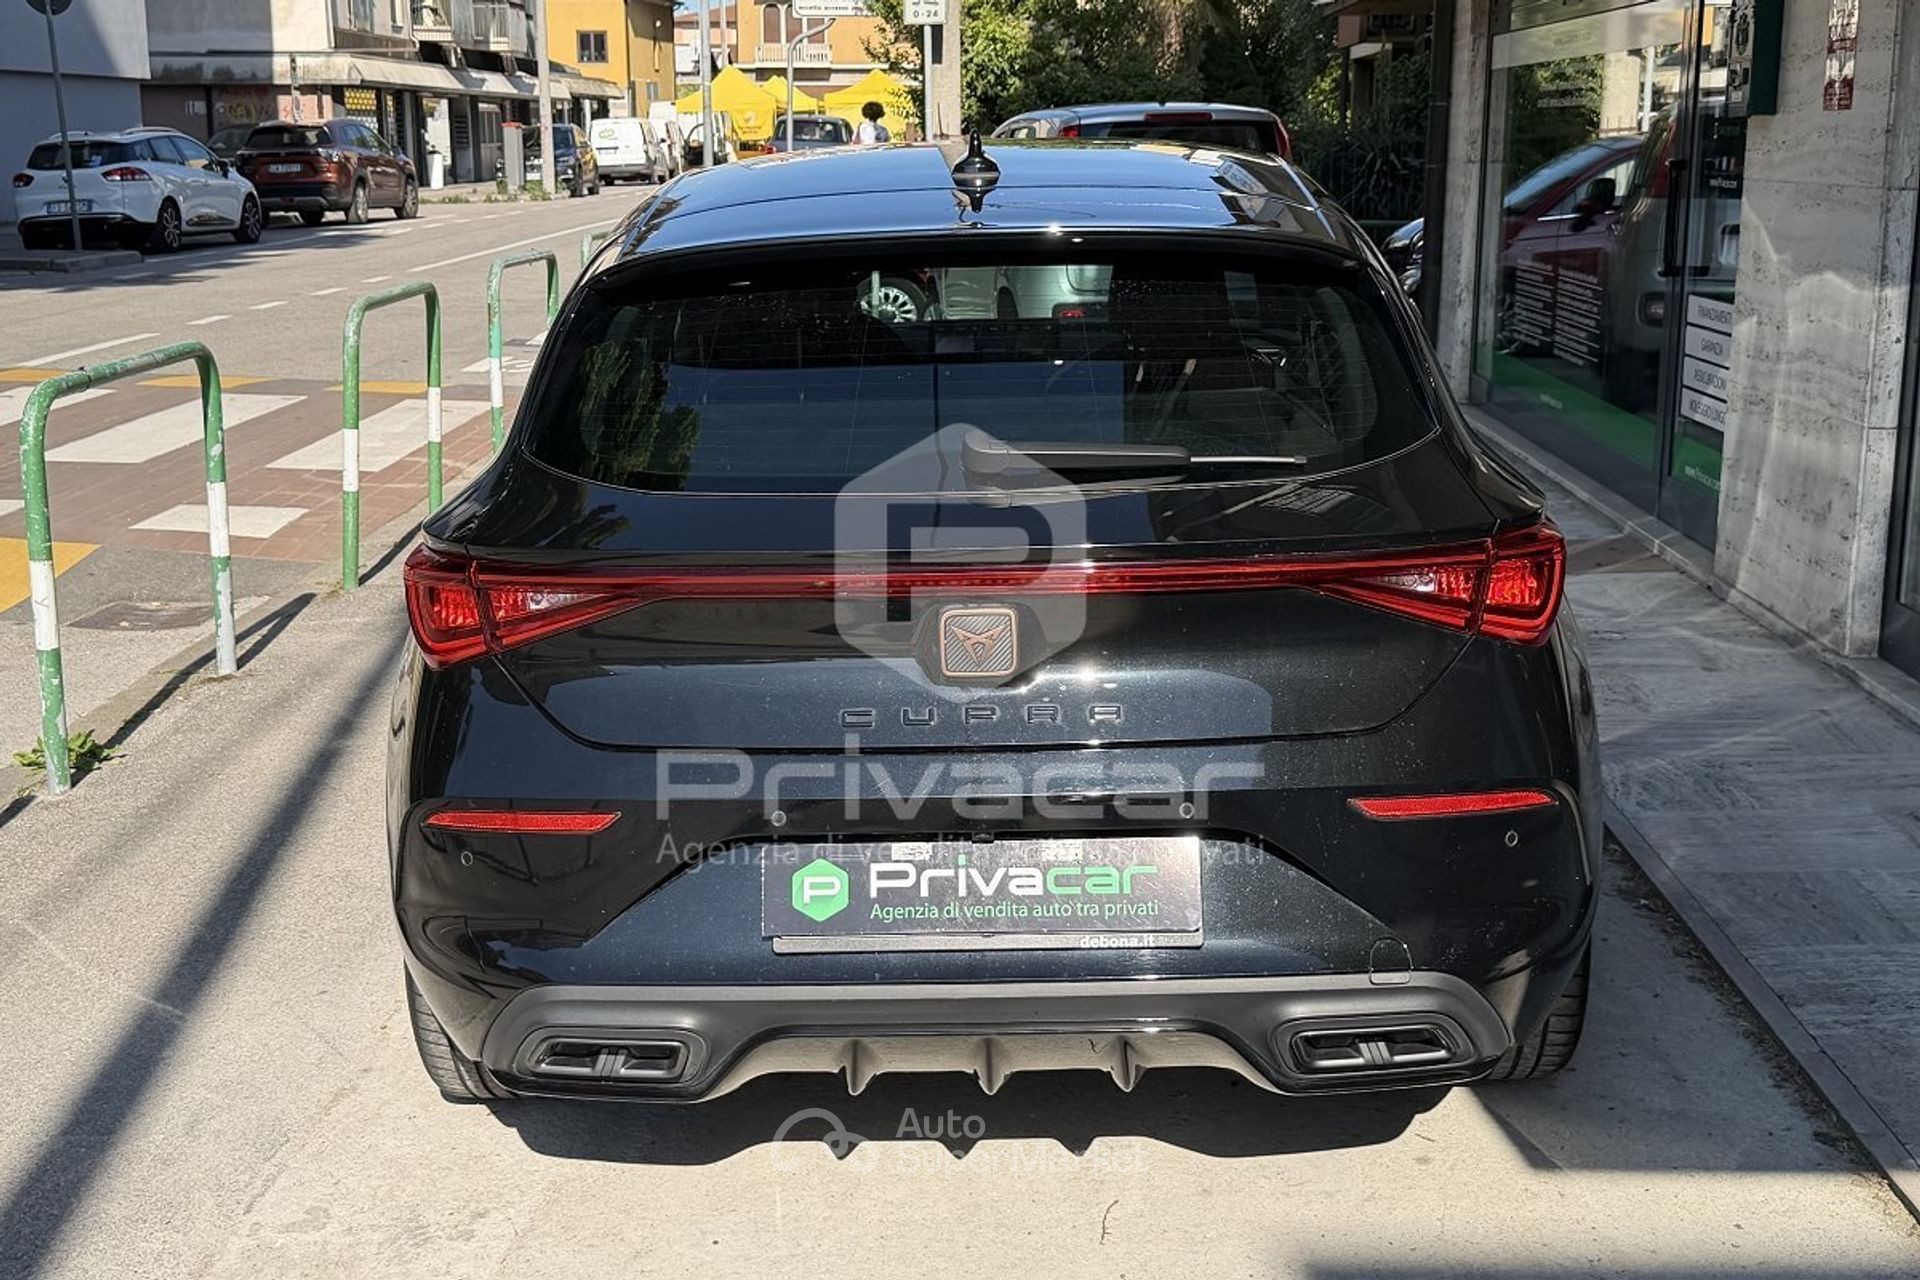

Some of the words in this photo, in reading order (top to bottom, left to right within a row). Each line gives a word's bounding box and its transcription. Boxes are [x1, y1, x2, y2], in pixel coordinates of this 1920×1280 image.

[840, 704, 1122, 729] CUPRA
[869, 854, 1158, 898] Privacar
[870, 903, 939, 923] Agenzia
[943, 902, 960, 918] di
[963, 901, 1027, 918] vendita
[1032, 903, 1073, 917] auto
[1077, 902, 1100, 917] tra
[1104, 900, 1159, 920] privati
[1079, 934, 1156, 949] debona.it
